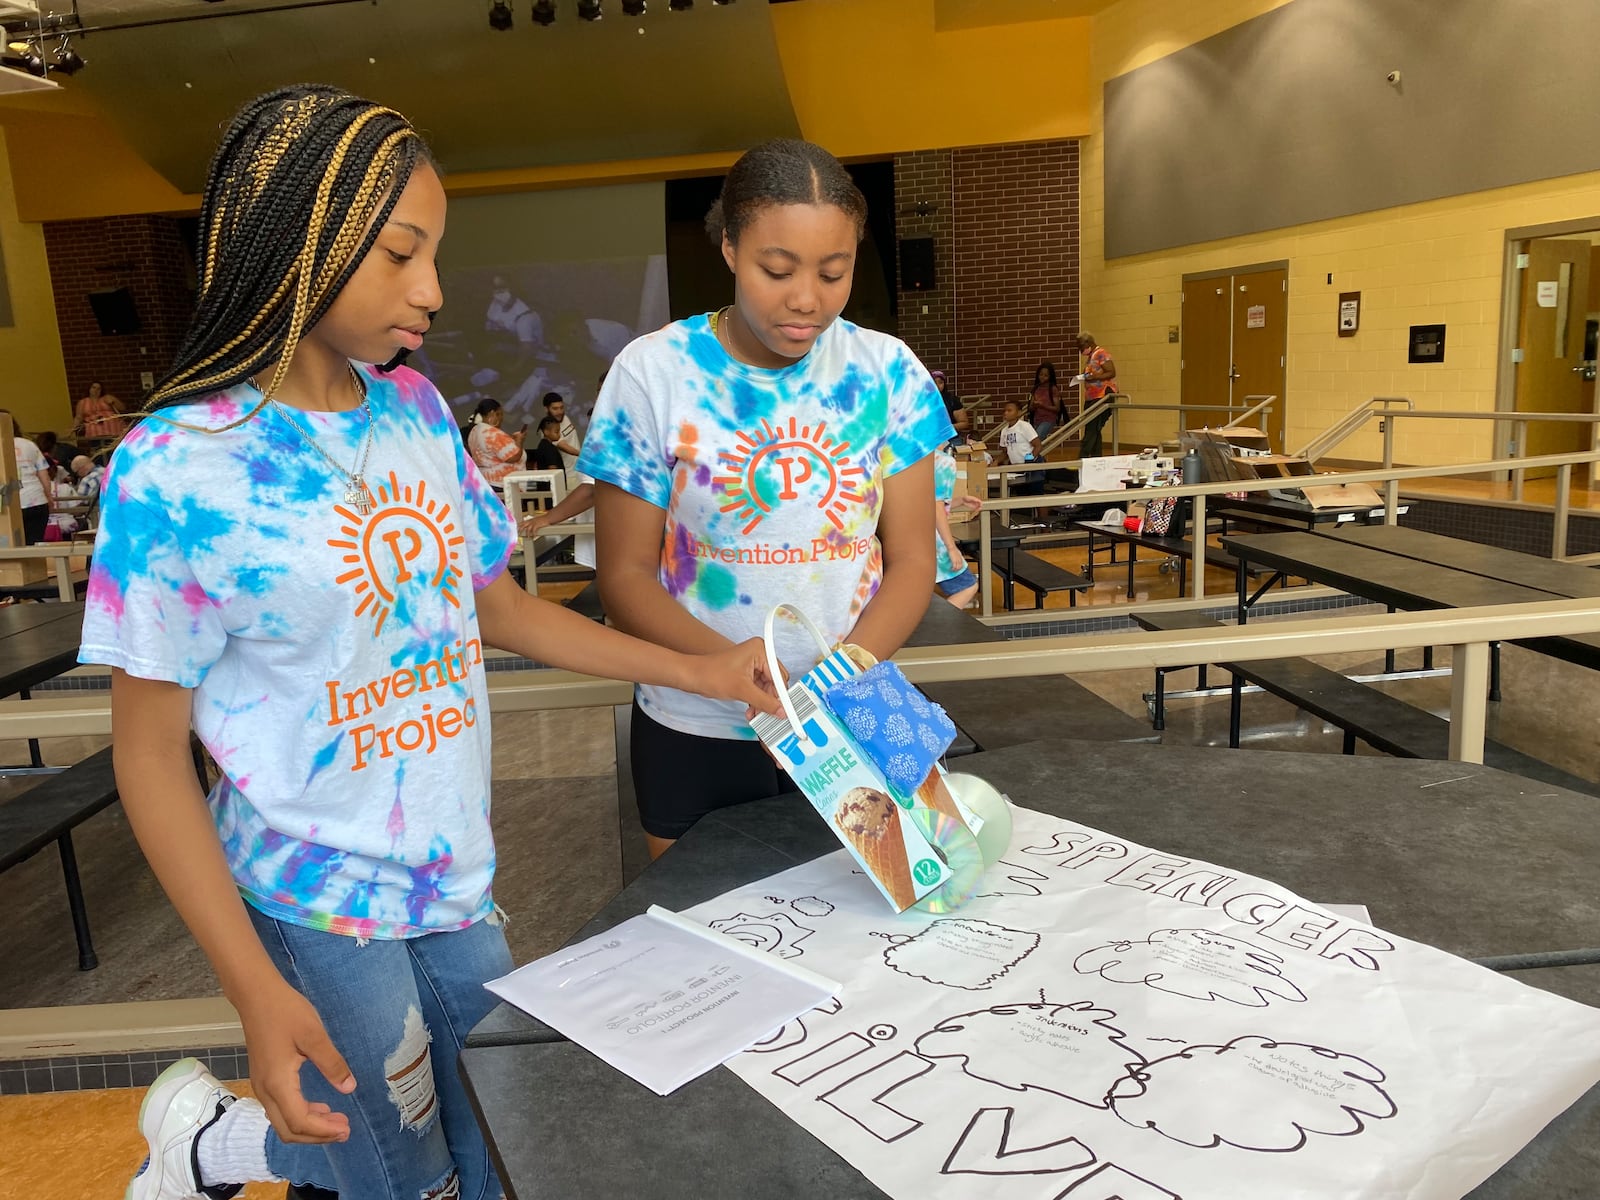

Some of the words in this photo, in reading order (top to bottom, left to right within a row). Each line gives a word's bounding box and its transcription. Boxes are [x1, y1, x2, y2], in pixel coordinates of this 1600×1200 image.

[686, 532, 806, 565] Invention
[811, 535, 875, 562] Projec
[325, 638, 482, 727] Inventin
[349, 697, 476, 771] Projec
[800, 747, 858, 797] WAFFLE
[915, 859, 937, 879] 12
[1021, 831, 1396, 971] SPENCER
[690, 974, 743, 1004] INVENTOR
[701, 989, 740, 1013] INVENTION
[626, 1001, 692, 1035] PORTFOLIO
